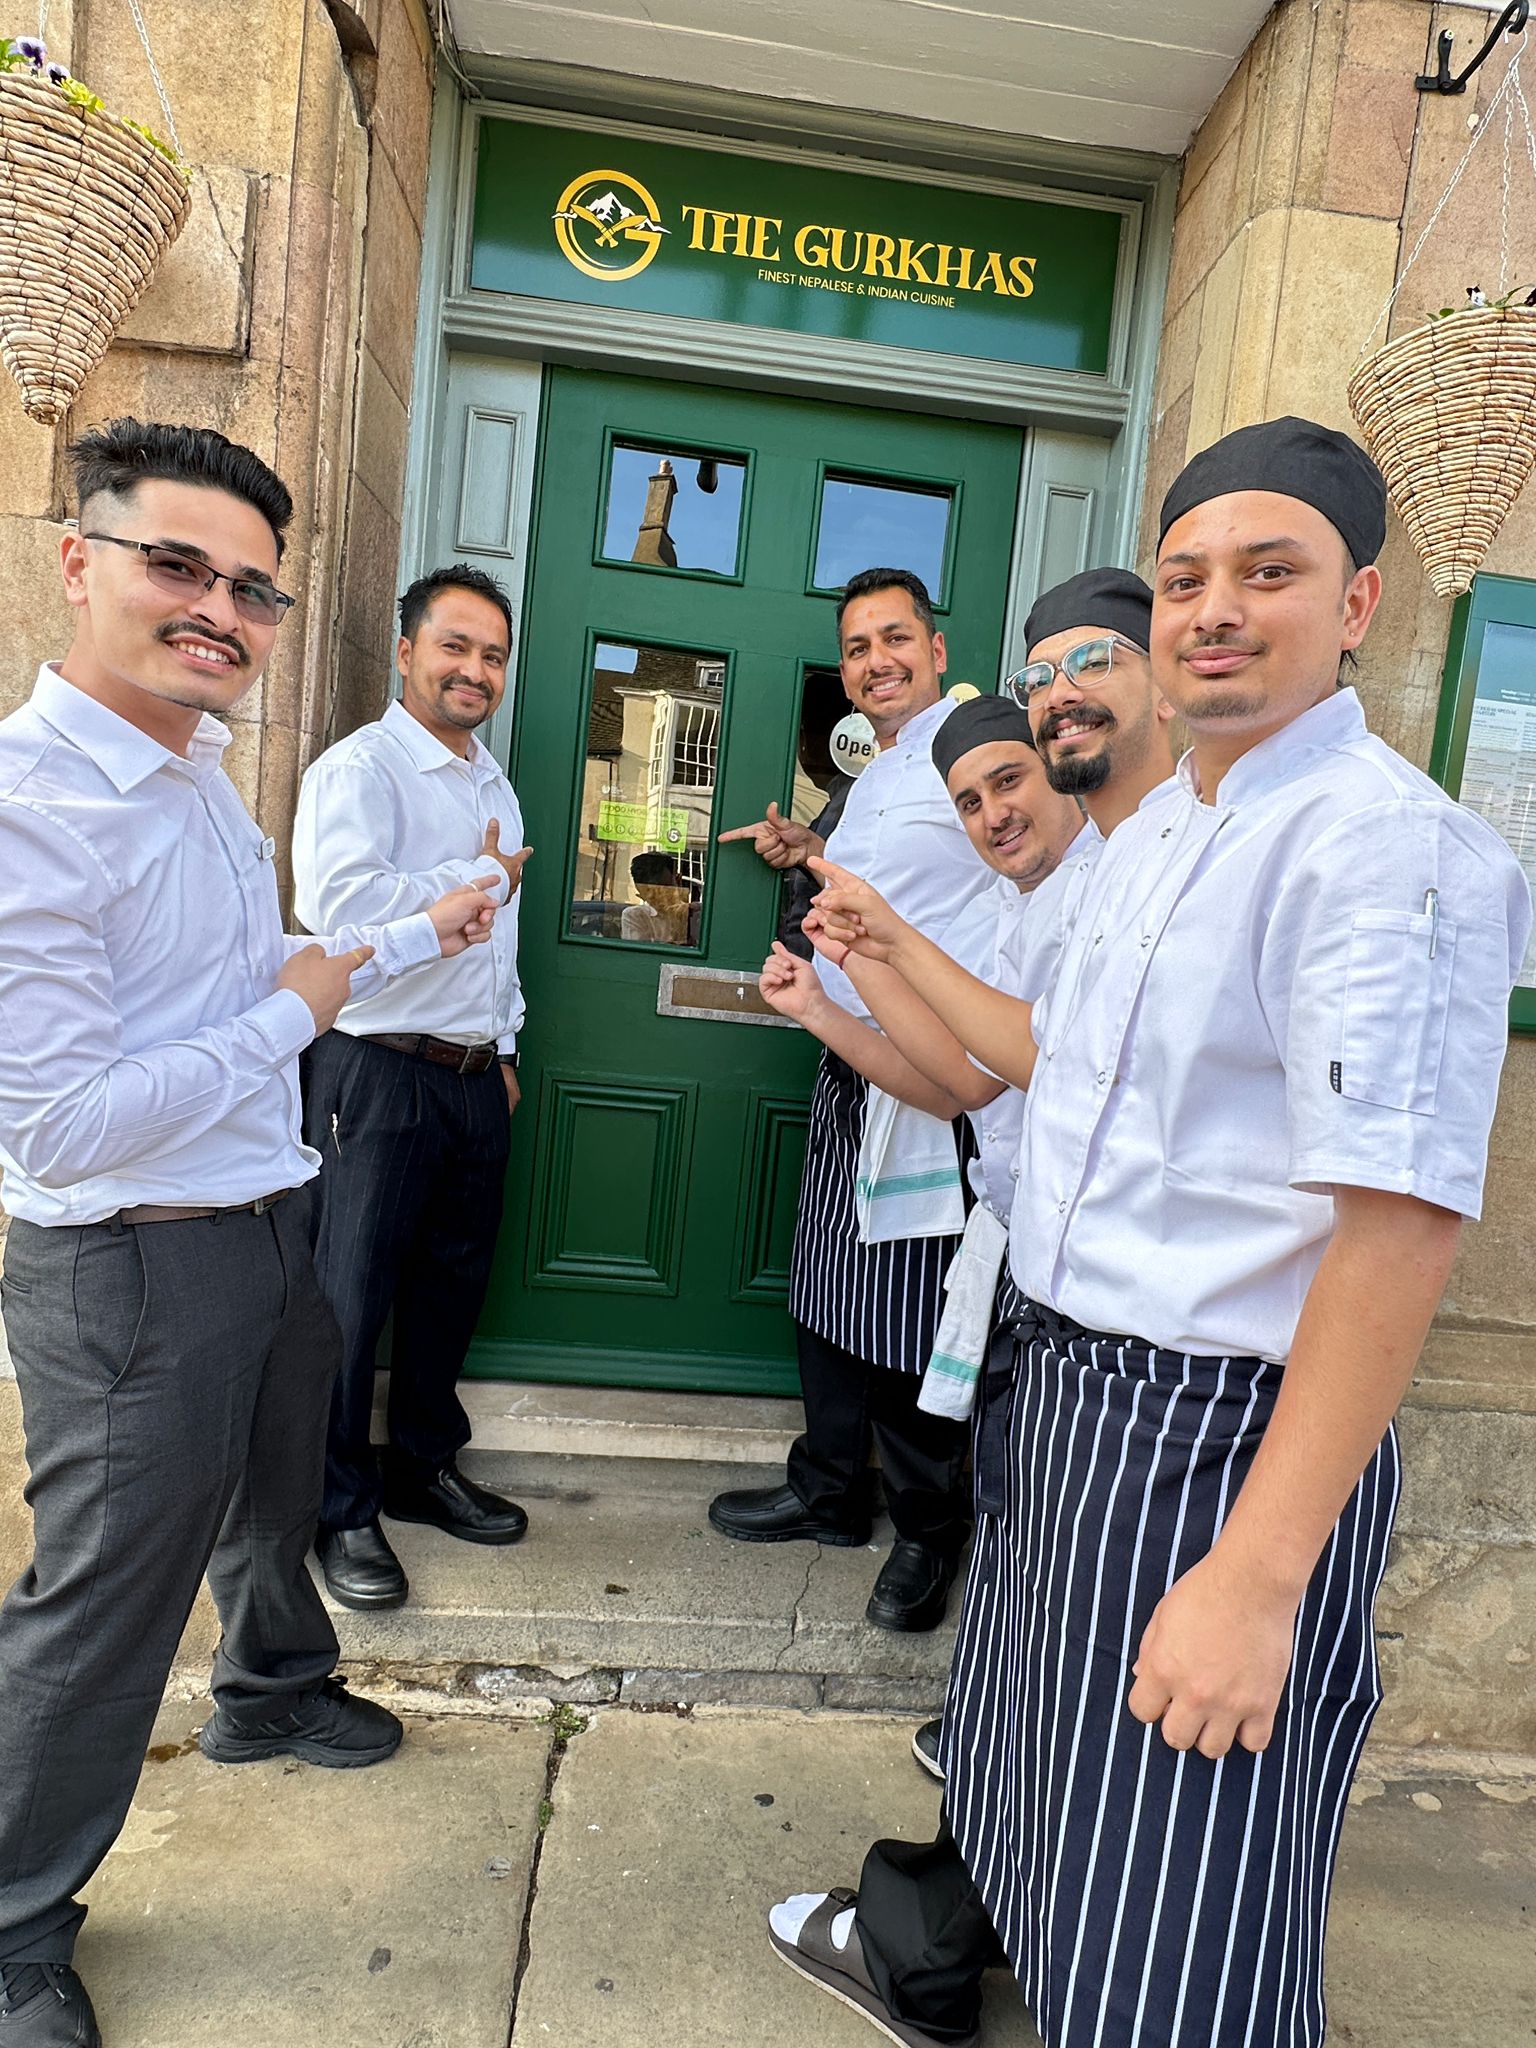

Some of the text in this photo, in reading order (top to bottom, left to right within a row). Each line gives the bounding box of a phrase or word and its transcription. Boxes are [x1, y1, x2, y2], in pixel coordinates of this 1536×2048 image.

[682, 204, 1038, 299] THE GURKHAS
[758, 269, 956, 309] FINEST NEPALESE & INDIAN CUISINE
[836, 733, 876, 758] Ope
